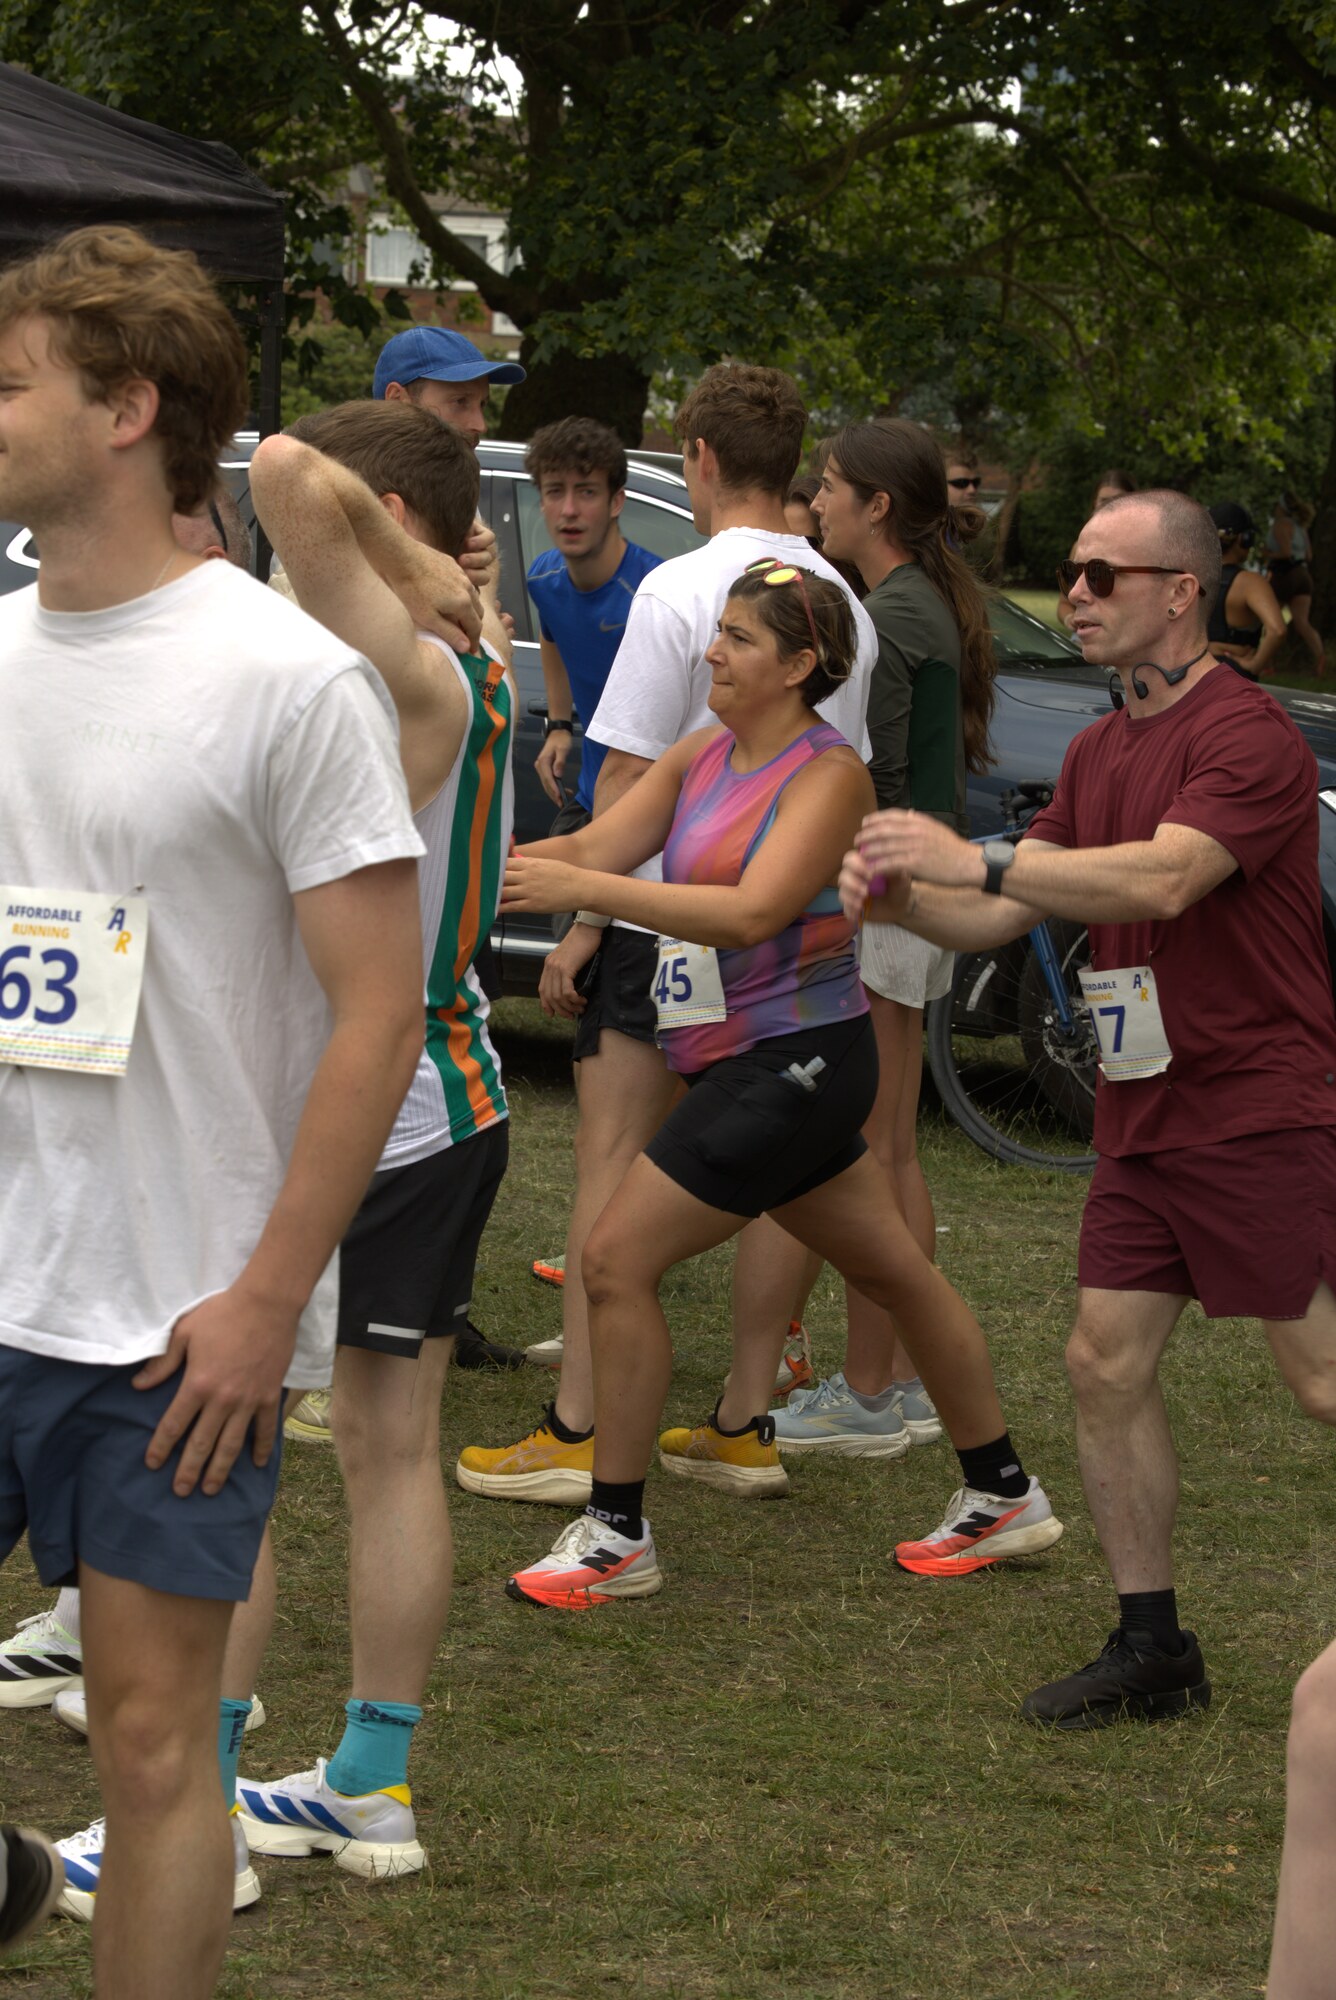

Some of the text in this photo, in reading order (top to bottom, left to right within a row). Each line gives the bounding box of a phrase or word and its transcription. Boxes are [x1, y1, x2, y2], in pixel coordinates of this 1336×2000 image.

[6, 905, 82, 922] AFFORDABLE
[106, 908, 126, 931] A
[12, 923, 71, 939] RUNNING
[114, 930, 132, 955] R
[0, 945, 79, 1025] 63
[655, 957, 692, 1005] 45
[1132, 973, 1142, 989] A
[1140, 986, 1150, 1002] R
